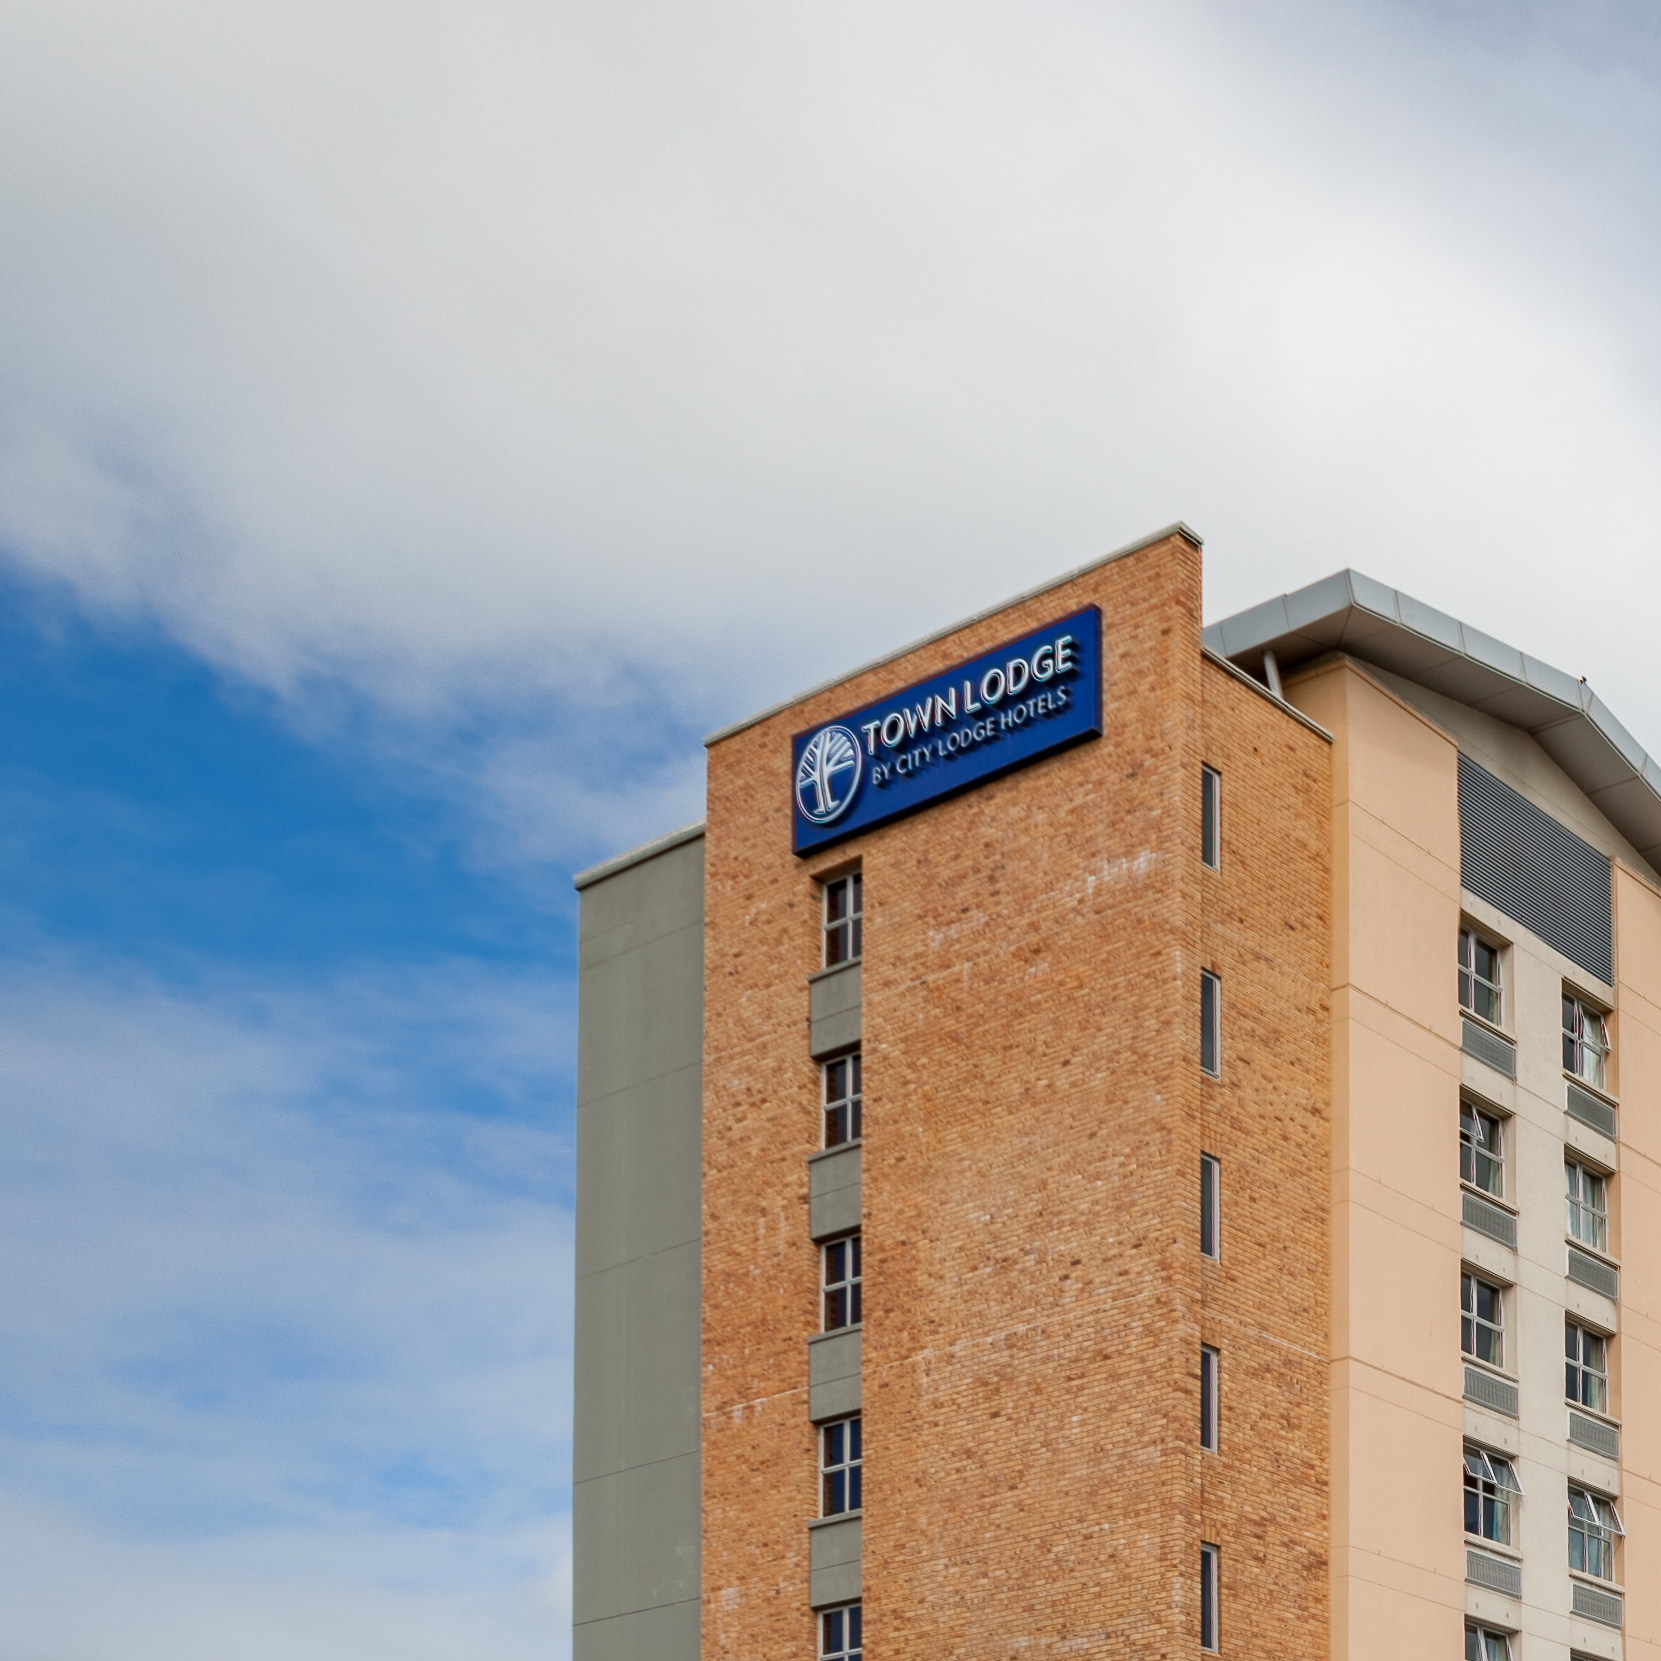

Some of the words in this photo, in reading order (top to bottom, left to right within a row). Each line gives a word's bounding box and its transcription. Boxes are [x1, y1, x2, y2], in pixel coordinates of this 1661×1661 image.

[862, 687, 957, 756] TOWN
[963, 634, 1073, 714] LODGE
[872, 762, 892, 785] BY
[896, 744, 932, 774] CITY
[937, 717, 996, 757] LODGE
[1001, 685, 1068, 730] HOTELS
